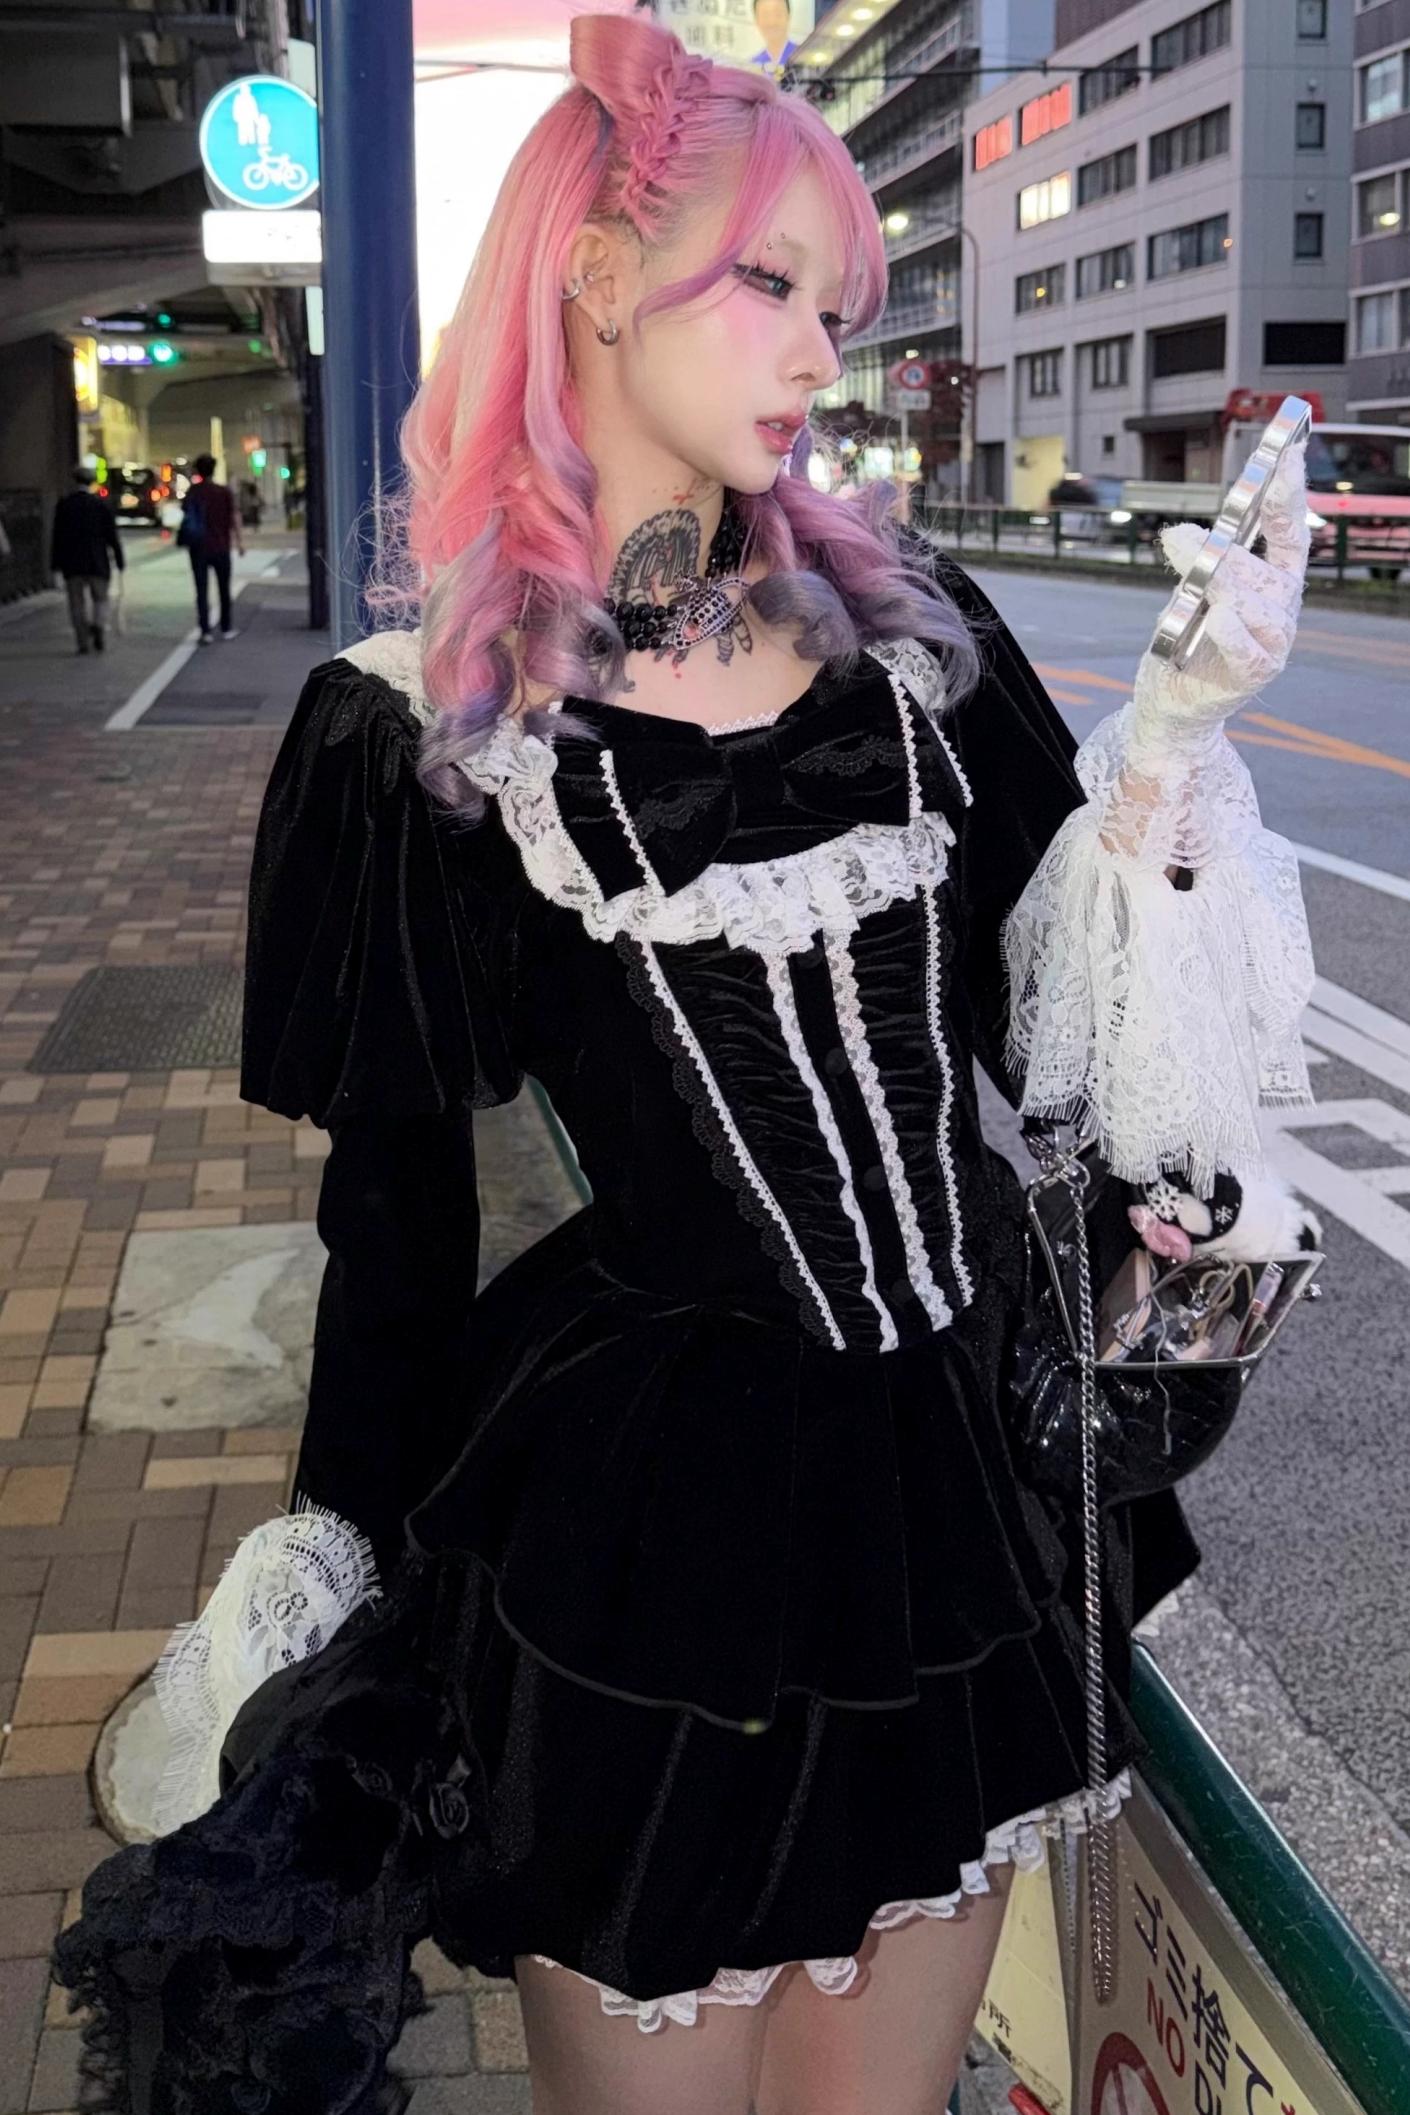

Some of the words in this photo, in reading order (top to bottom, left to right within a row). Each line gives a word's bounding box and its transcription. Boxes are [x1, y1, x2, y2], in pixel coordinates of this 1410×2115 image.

[1134, 1881, 1296, 2115] ゴミ捨て
[1147, 1976, 1185, 2078] NO
